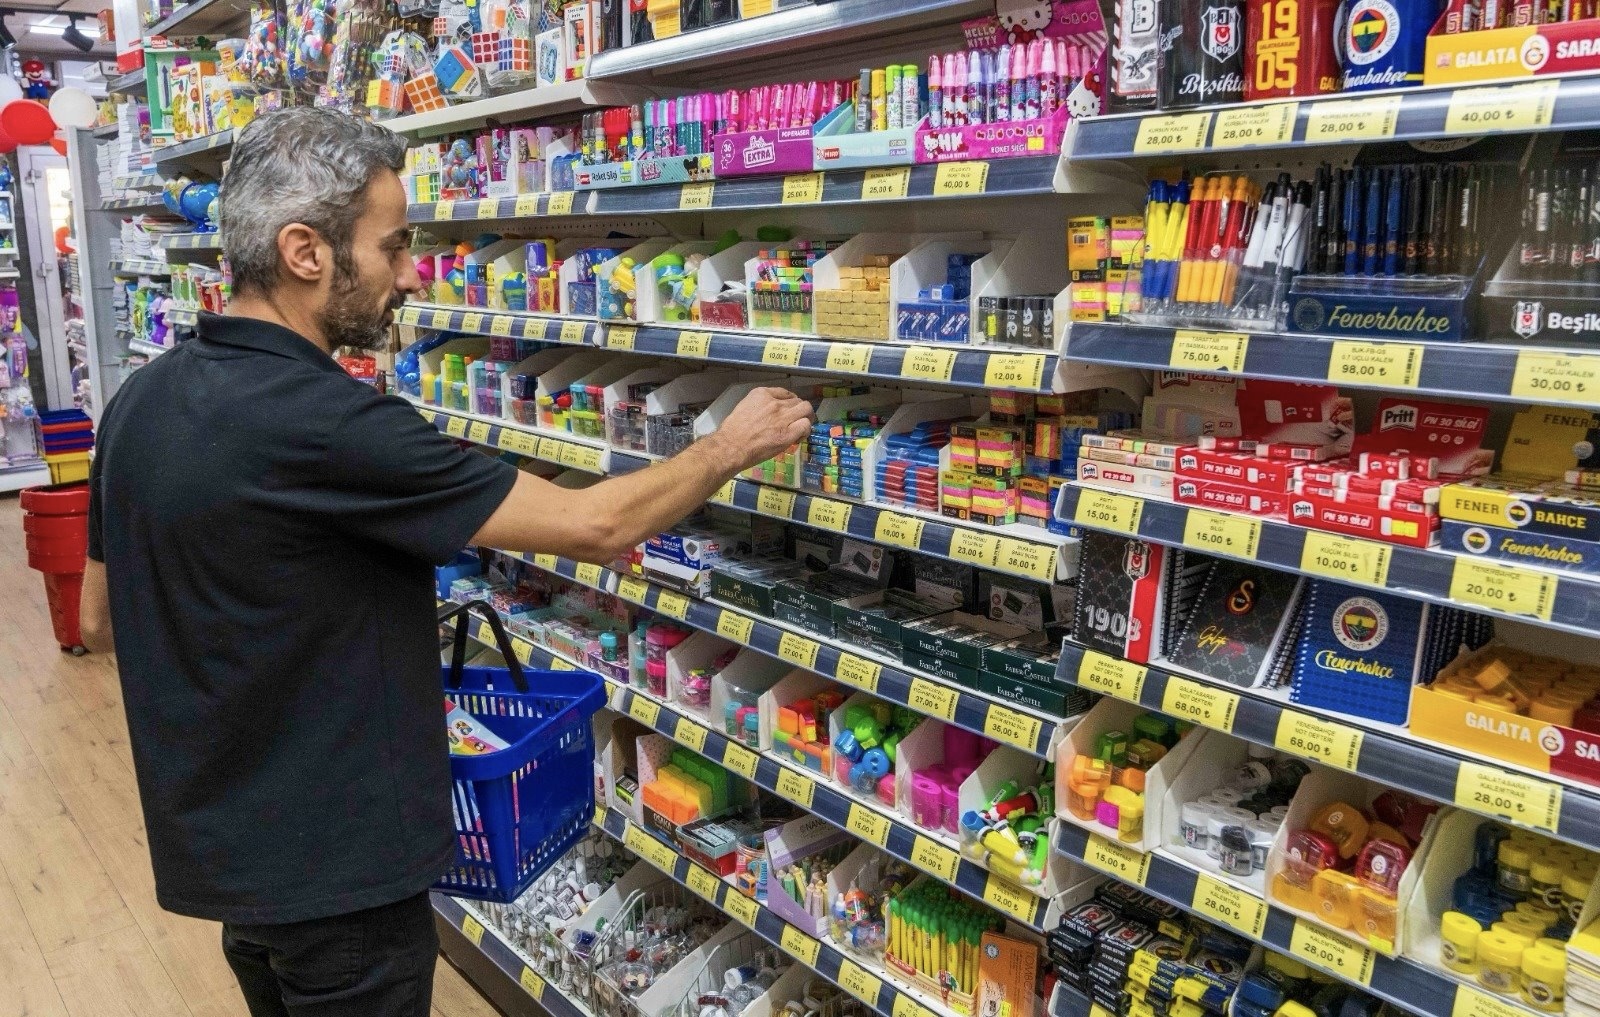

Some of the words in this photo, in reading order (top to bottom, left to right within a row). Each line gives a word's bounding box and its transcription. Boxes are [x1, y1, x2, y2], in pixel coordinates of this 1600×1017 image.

[1262, 0, 1299, 41] 19
[965, 26, 995, 38] HELLO
[1456, 48, 1517, 68] GALATA
[1256, 52, 1299, 91] 05
[1462, 111, 1500, 123] 40,00
[1223, 129, 1253, 140] 28,00
[1322, 123, 1353, 133] 28,00
[1147, 136, 1173, 146] 28,00
[747, 149, 772, 162] EXTRA
[944, 179, 963, 188] 40,00
[1182, 351, 1210, 362] 75,00
[912, 362, 929, 372] 13,00
[1341, 364, 1375, 376] 98,00
[993, 371, 1013, 381] 12,00
[1530, 377, 1571, 391] 30,00
[1384, 410, 1415, 424] Pritt
[1543, 414, 1587, 428] FENER
[1182, 457, 1196, 467] Pritt
[1083, 466, 1096, 477] Pritt
[1180, 487, 1195, 498] Pritt
[1295, 504, 1312, 515] Pritt
[1455, 498, 1500, 514] FENER
[1086, 508, 1110, 521] 15,00
[1196, 532, 1222, 544] 15,00
[957, 546, 977, 558] 23,00
[1008, 557, 1029, 570] 36,00
[1316, 557, 1347, 570] 10,00
[1466, 583, 1503, 599] 20,00
[1089, 673, 1114, 688] 68,00
[1175, 700, 1201, 716] 68,00
[992, 723, 1012, 738] 35,00
[1464, 711, 1533, 743] GALATA
[1290, 736, 1321, 753] 68,00
[1474, 791, 1512, 809] 28,00
[1095, 851, 1119, 868] 15,00
[1205, 897, 1231, 916] 28,00
[1303, 942, 1334, 962] 28,00
